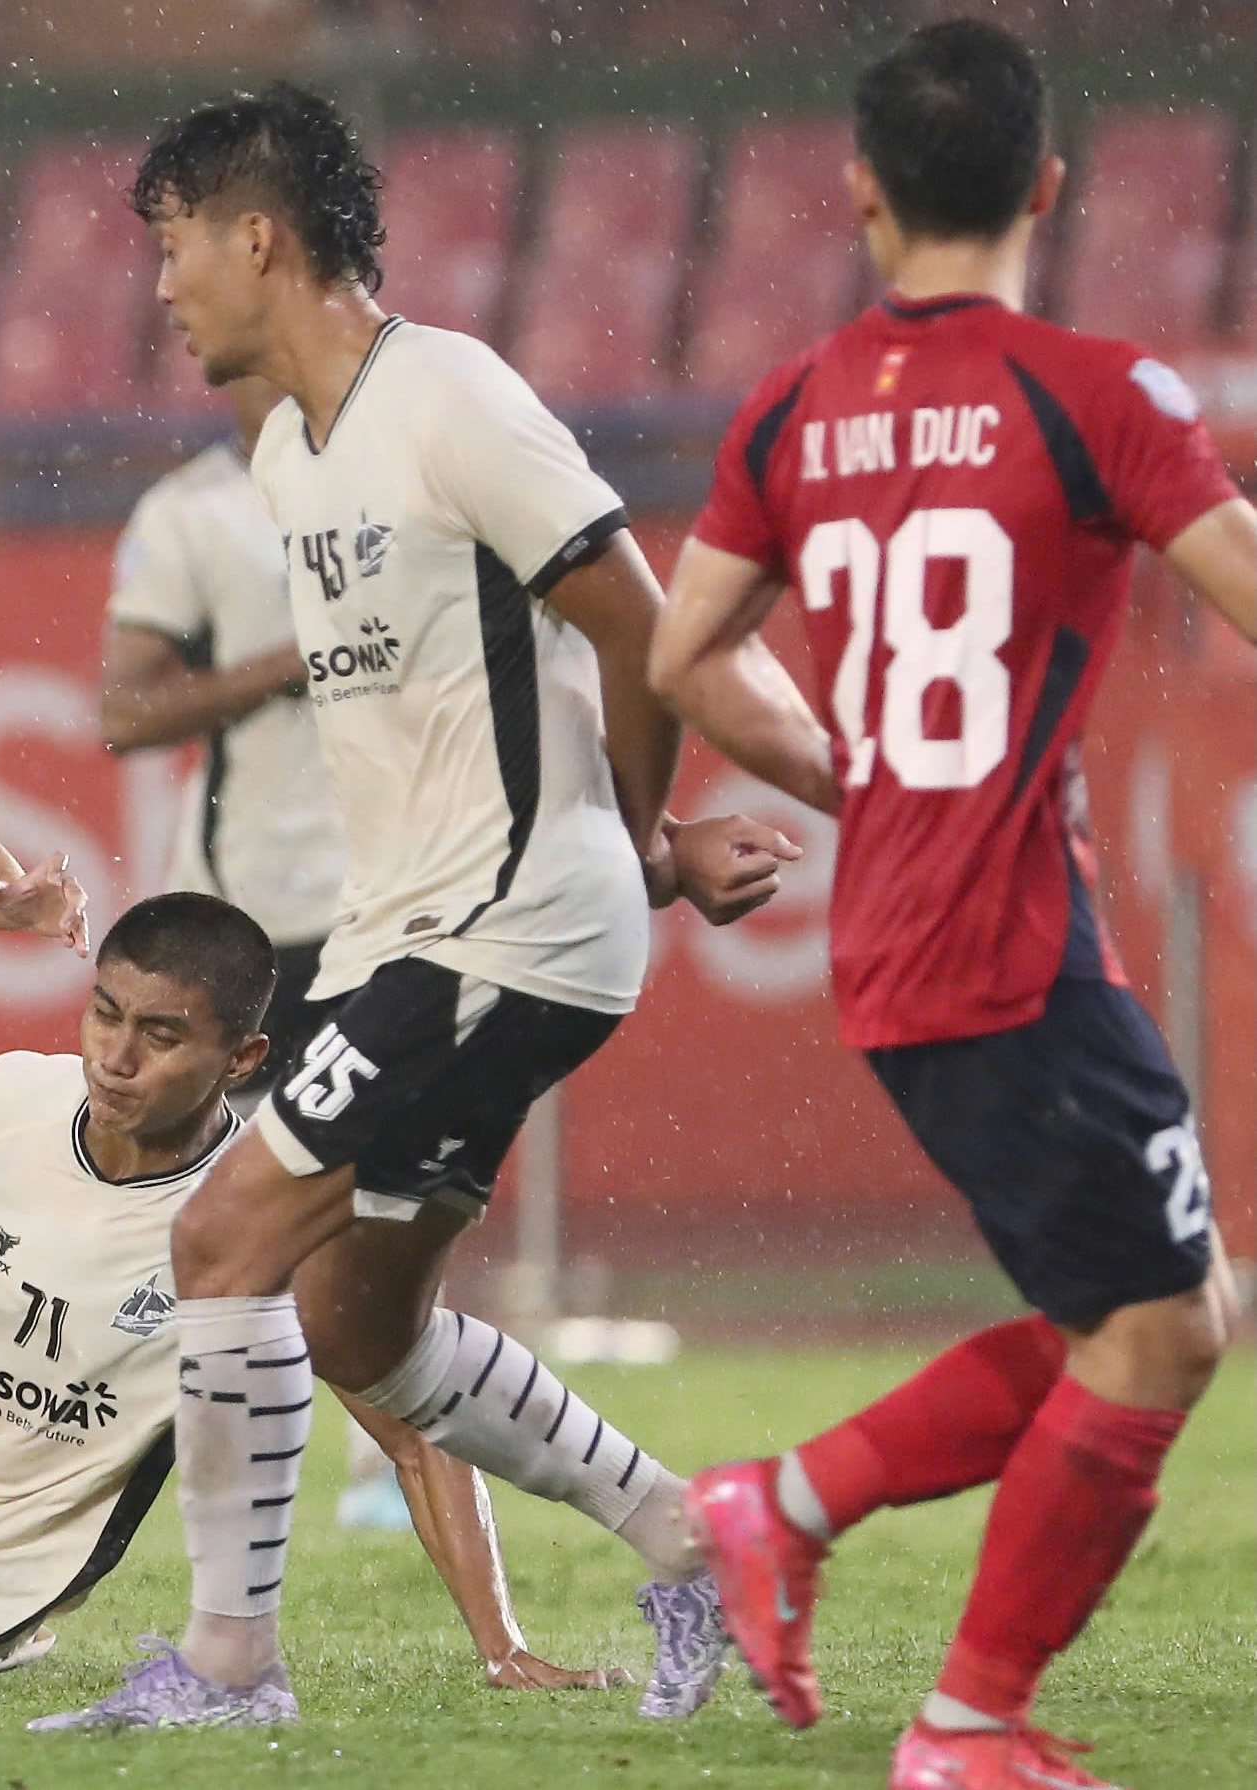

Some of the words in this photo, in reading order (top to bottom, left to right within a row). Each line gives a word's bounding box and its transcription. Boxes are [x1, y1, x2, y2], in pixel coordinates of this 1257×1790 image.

[911, 404, 1000, 468] DUC
[302, 529, 347, 601] 45
[308, 644, 393, 682] SOWA
[801, 508, 1013, 788] 28
[283, 1022, 381, 1121] 45
[13, 1281, 69, 1362] 71
